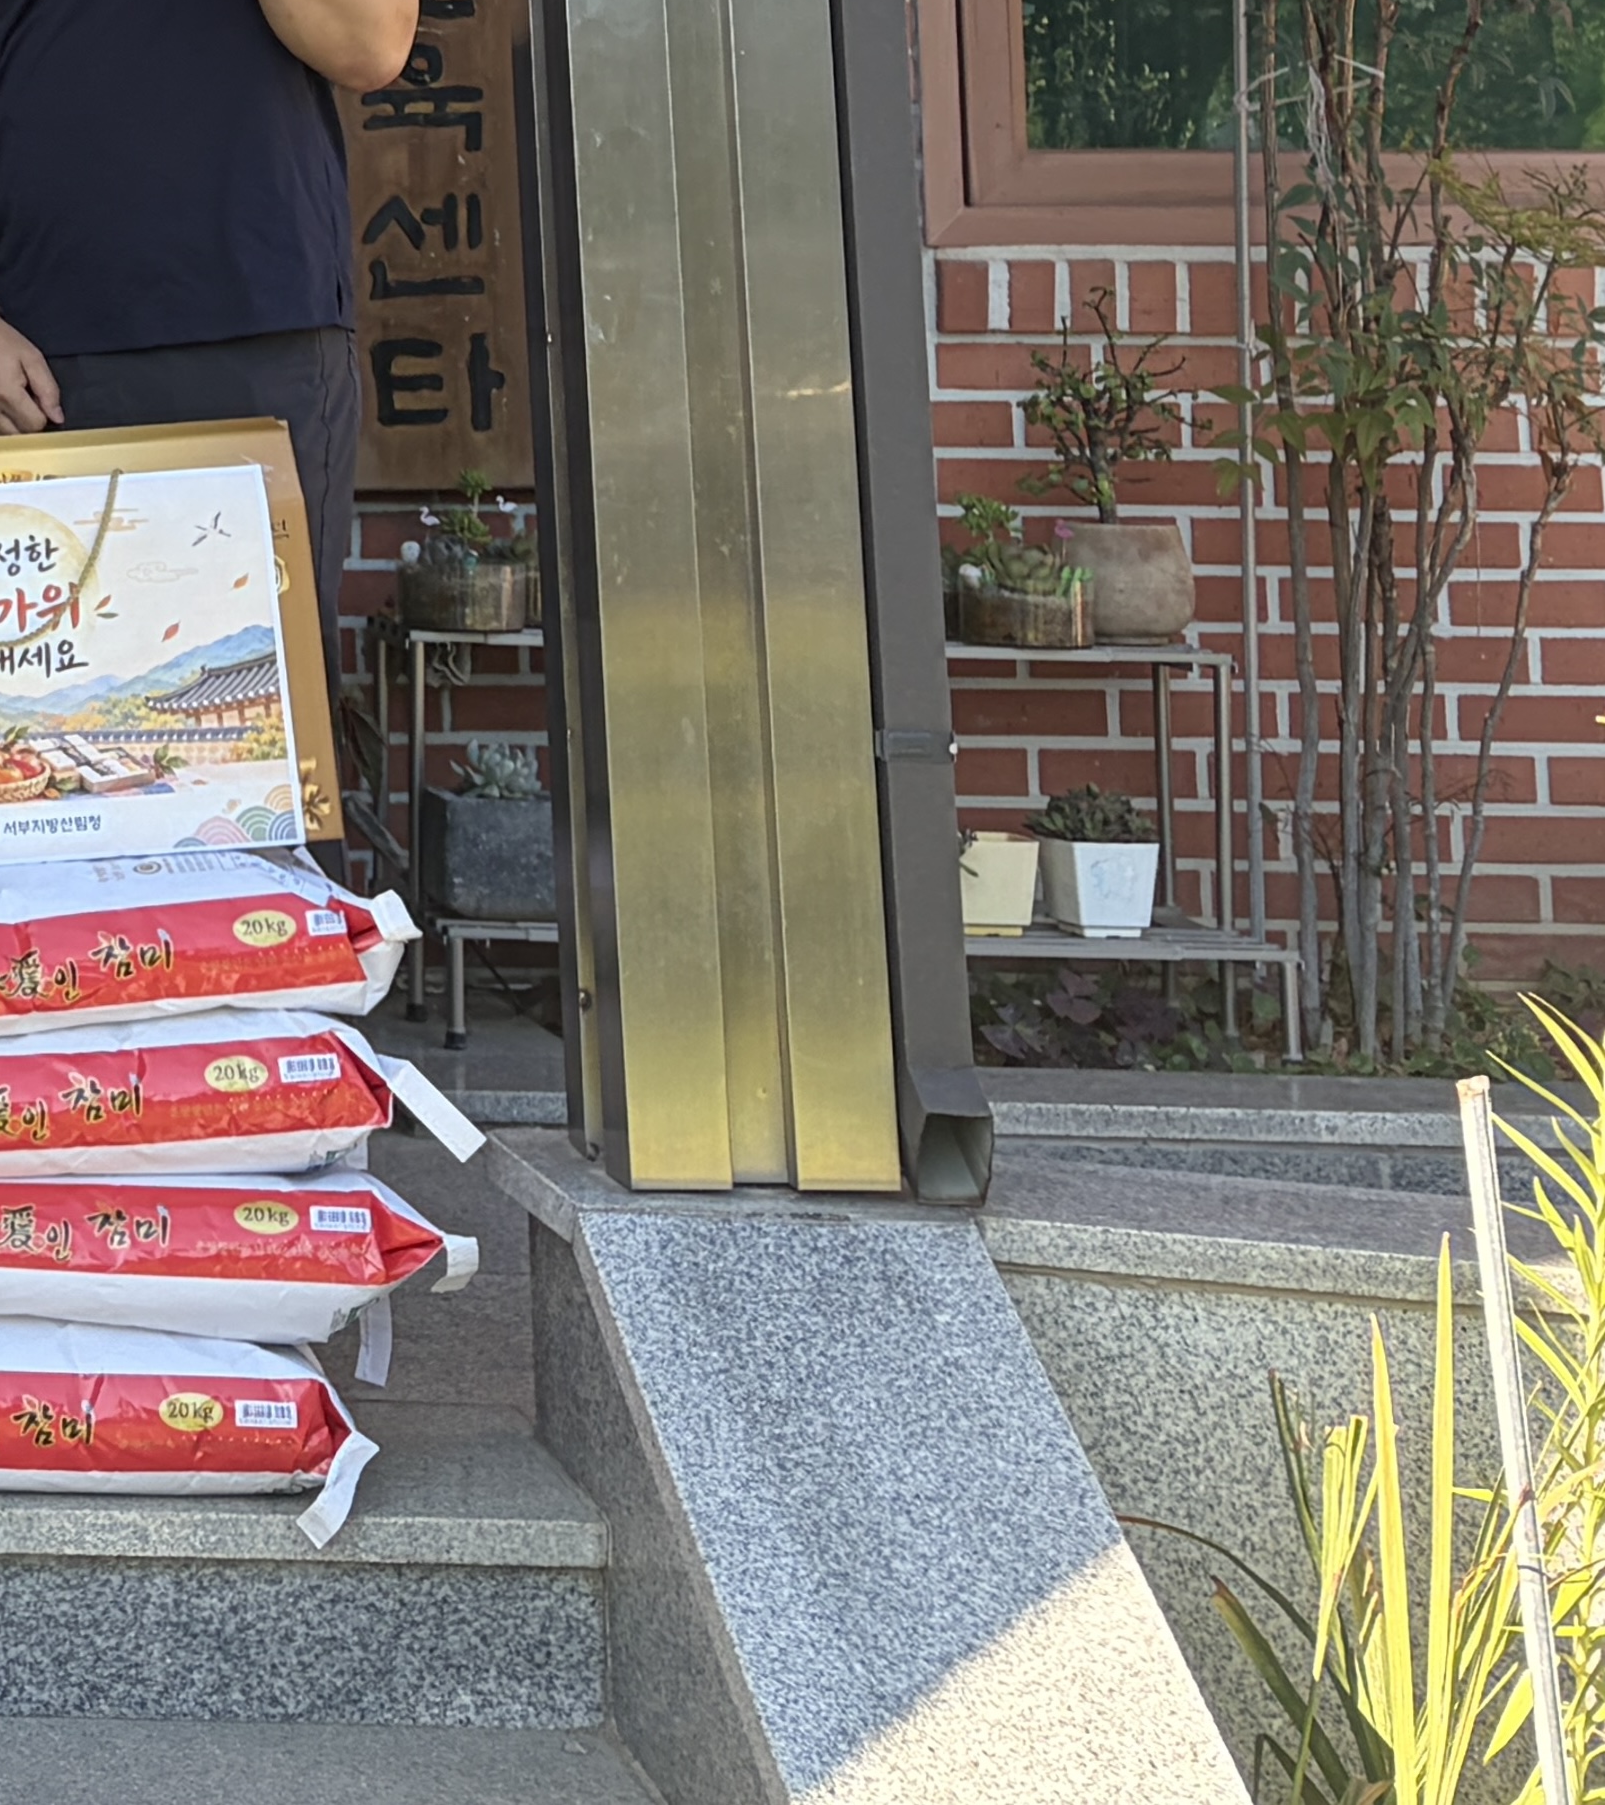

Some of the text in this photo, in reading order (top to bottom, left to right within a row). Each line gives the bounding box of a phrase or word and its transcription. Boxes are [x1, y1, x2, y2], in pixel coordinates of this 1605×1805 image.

[3, 813, 103, 836] 서부지방산림청
[90, 928, 176, 981] 참미
[57, 1070, 145, 1123] 참미
[83, 1197, 171, 1248] 참미
[10, 1393, 96, 1448] 참미
